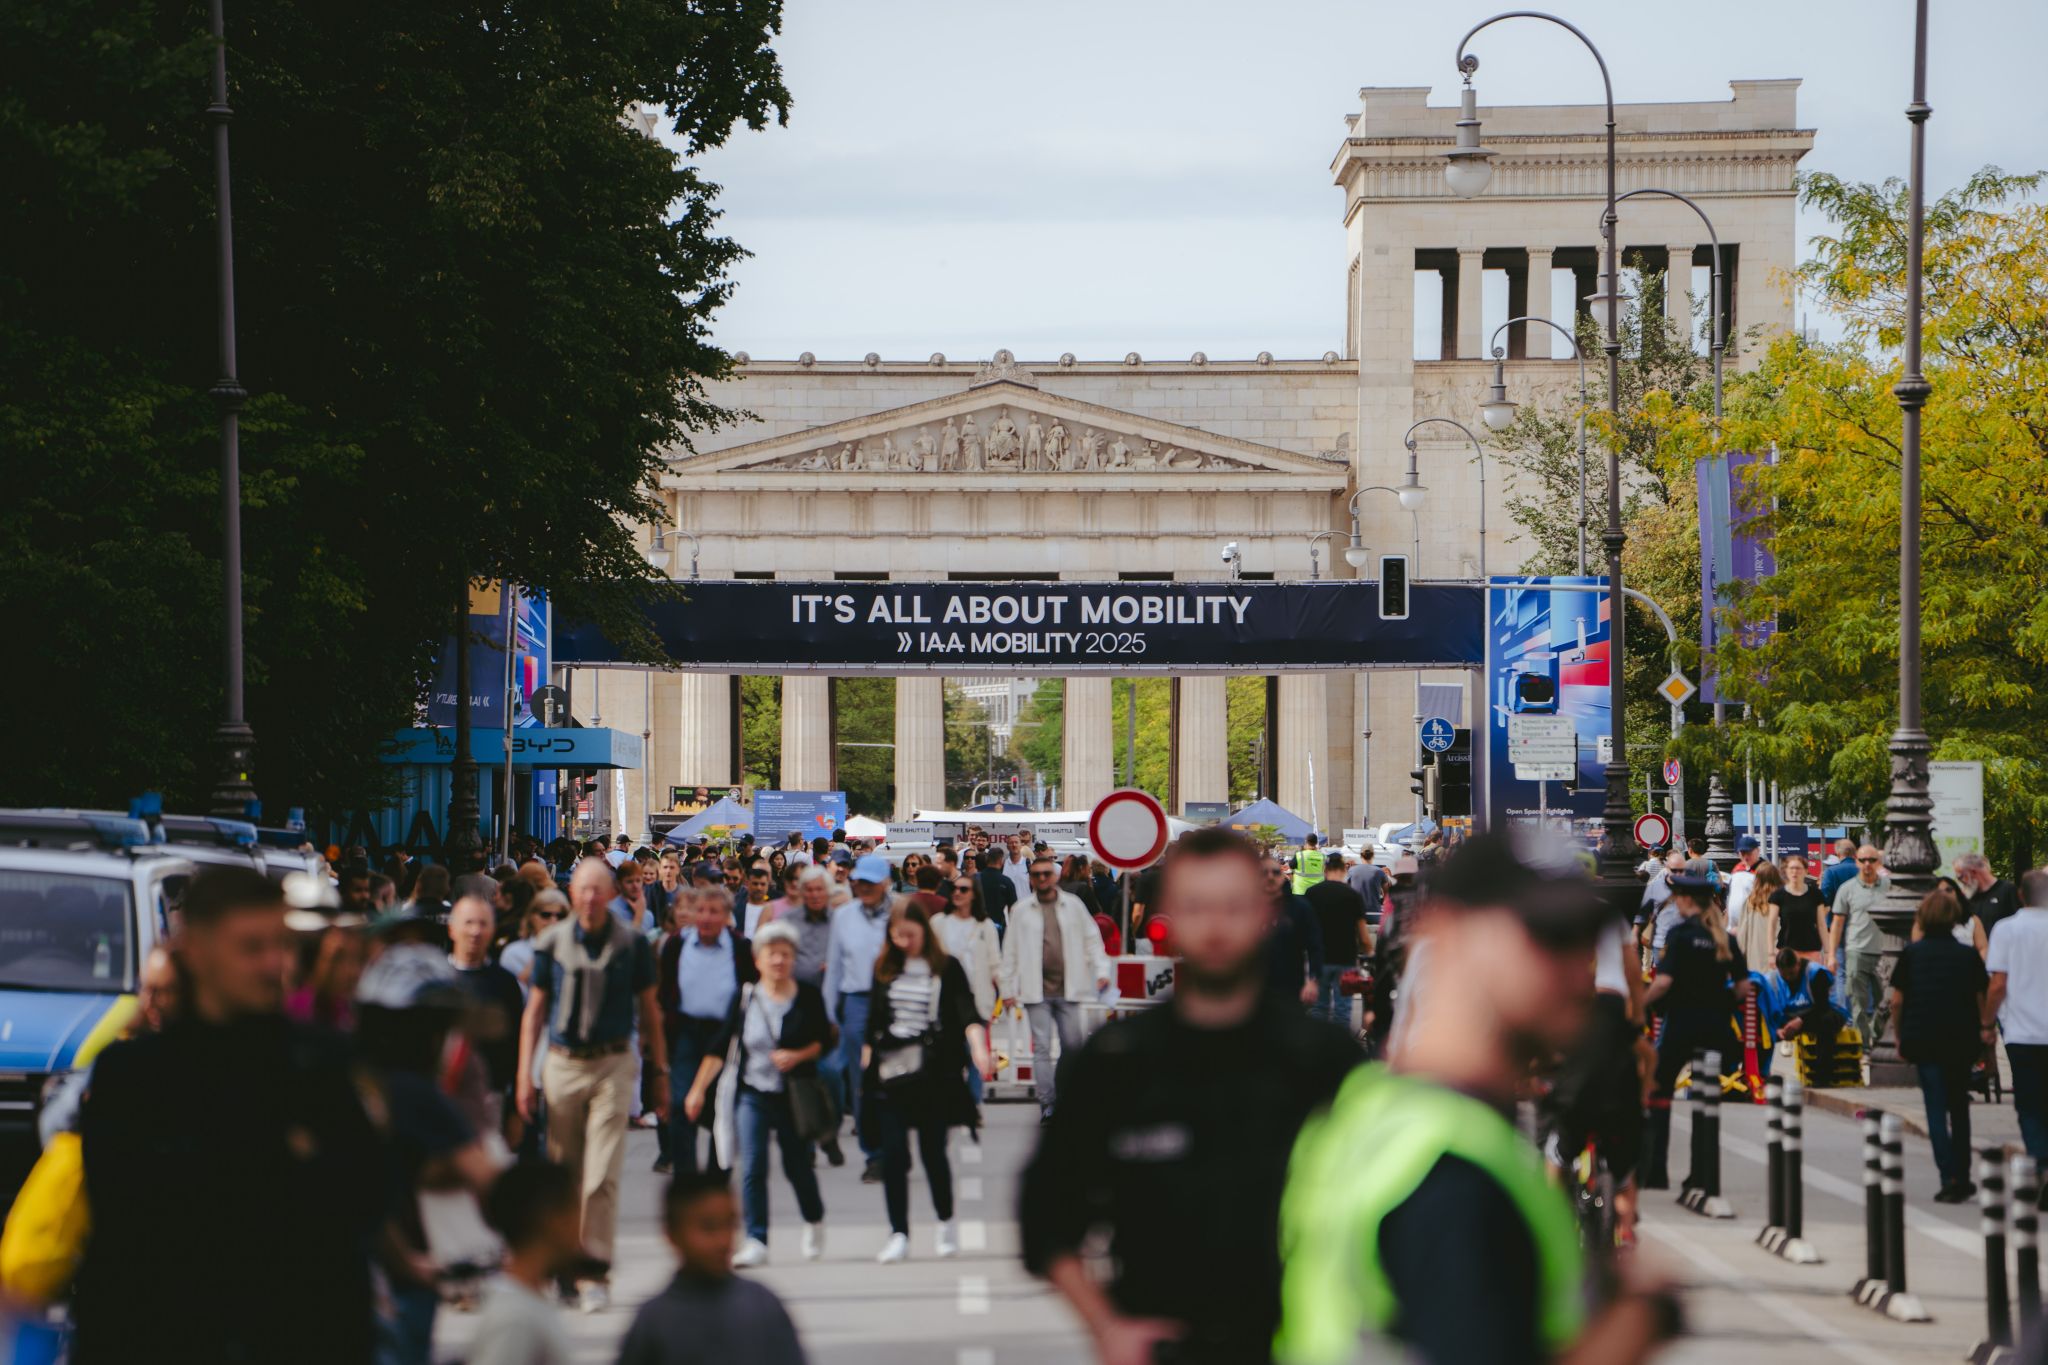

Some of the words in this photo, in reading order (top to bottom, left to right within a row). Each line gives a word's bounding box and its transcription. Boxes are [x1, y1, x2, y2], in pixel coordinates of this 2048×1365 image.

[792, 595, 856, 623] IT'S
[867, 596, 932, 623] ALL
[943, 595, 1069, 624] ABOUT
[1081, 595, 1252, 624] MOBILITY
[920, 632, 965, 653] IAA
[971, 632, 1082, 654] MOBILITY
[1086, 632, 1147, 654] 2025
[511, 738, 575, 753] BYD
